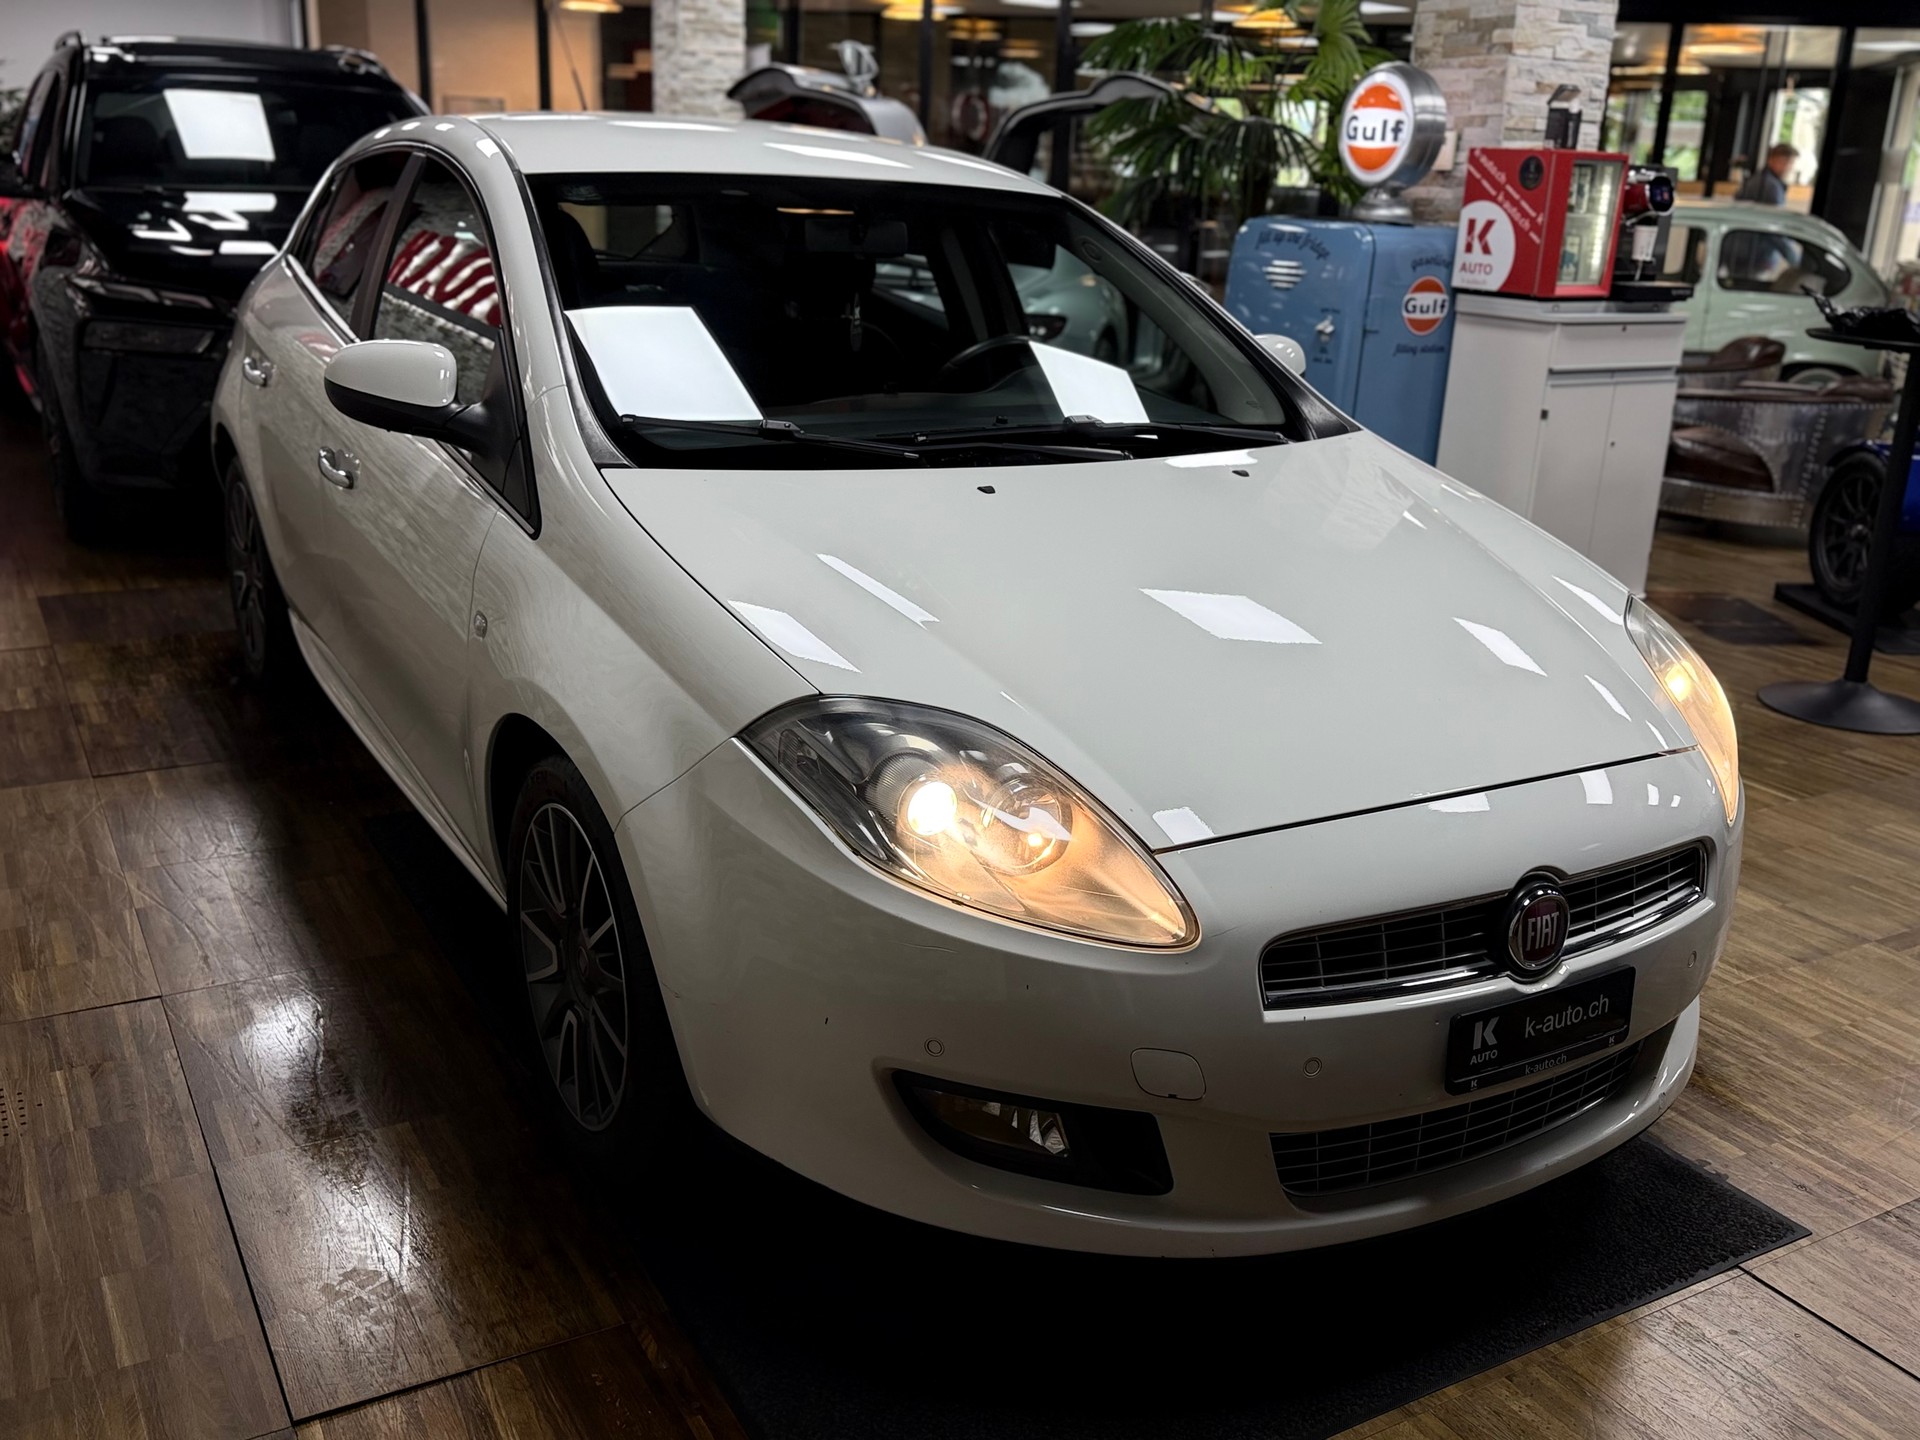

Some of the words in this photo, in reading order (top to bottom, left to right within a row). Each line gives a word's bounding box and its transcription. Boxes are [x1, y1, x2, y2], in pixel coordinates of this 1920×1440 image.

[1346, 115, 1404, 142] Gulf
[1464, 218, 1496, 255] K
[1459, 261, 1493, 276] AUTO
[1404, 297, 1448, 315] Gulf
[1526, 911, 1560, 951] FIAT
[1524, 994, 1610, 1039] k-auto.ch
[1472, 1015, 1500, 1051] K
[1469, 1049, 1499, 1066] AUTO
[1524, 1053, 1567, 1076] k-auto.ch
